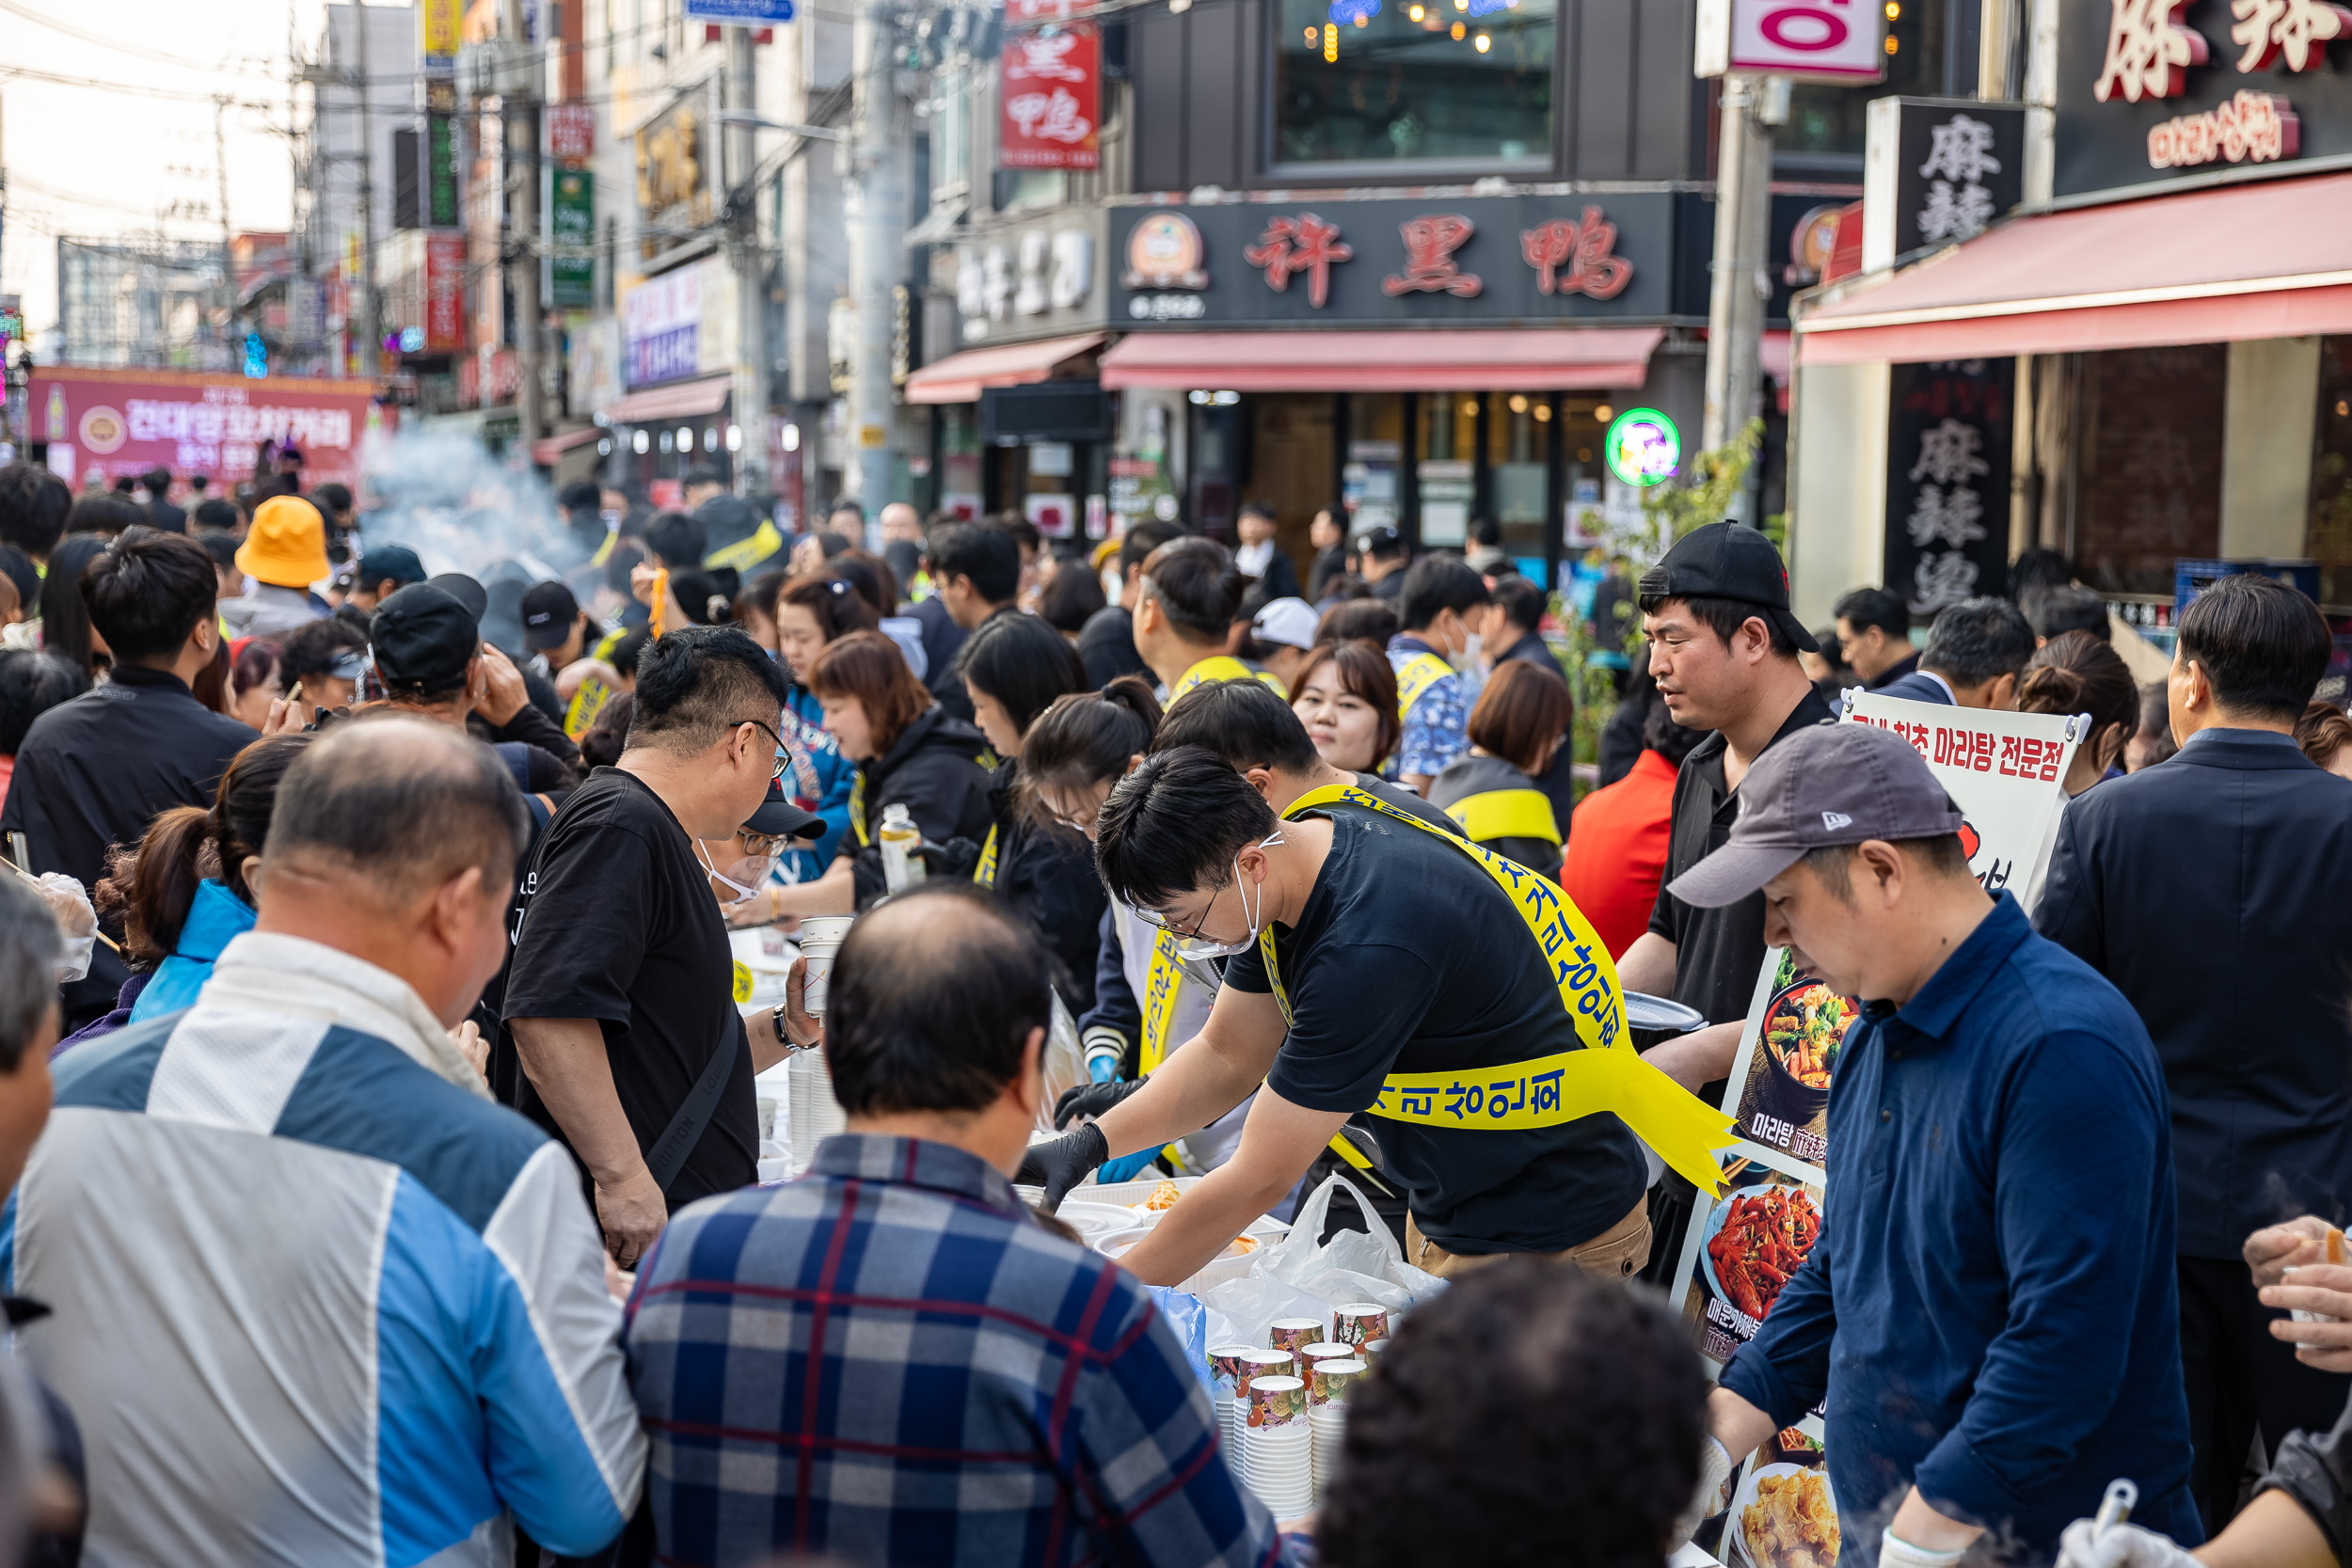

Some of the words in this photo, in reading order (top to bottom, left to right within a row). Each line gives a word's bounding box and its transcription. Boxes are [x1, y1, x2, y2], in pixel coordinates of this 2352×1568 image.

[1933, 727, 1996, 772] 마라탕
[1999, 736, 2064, 783] 전문점
[1751, 1112, 1794, 1148] 마라탕
